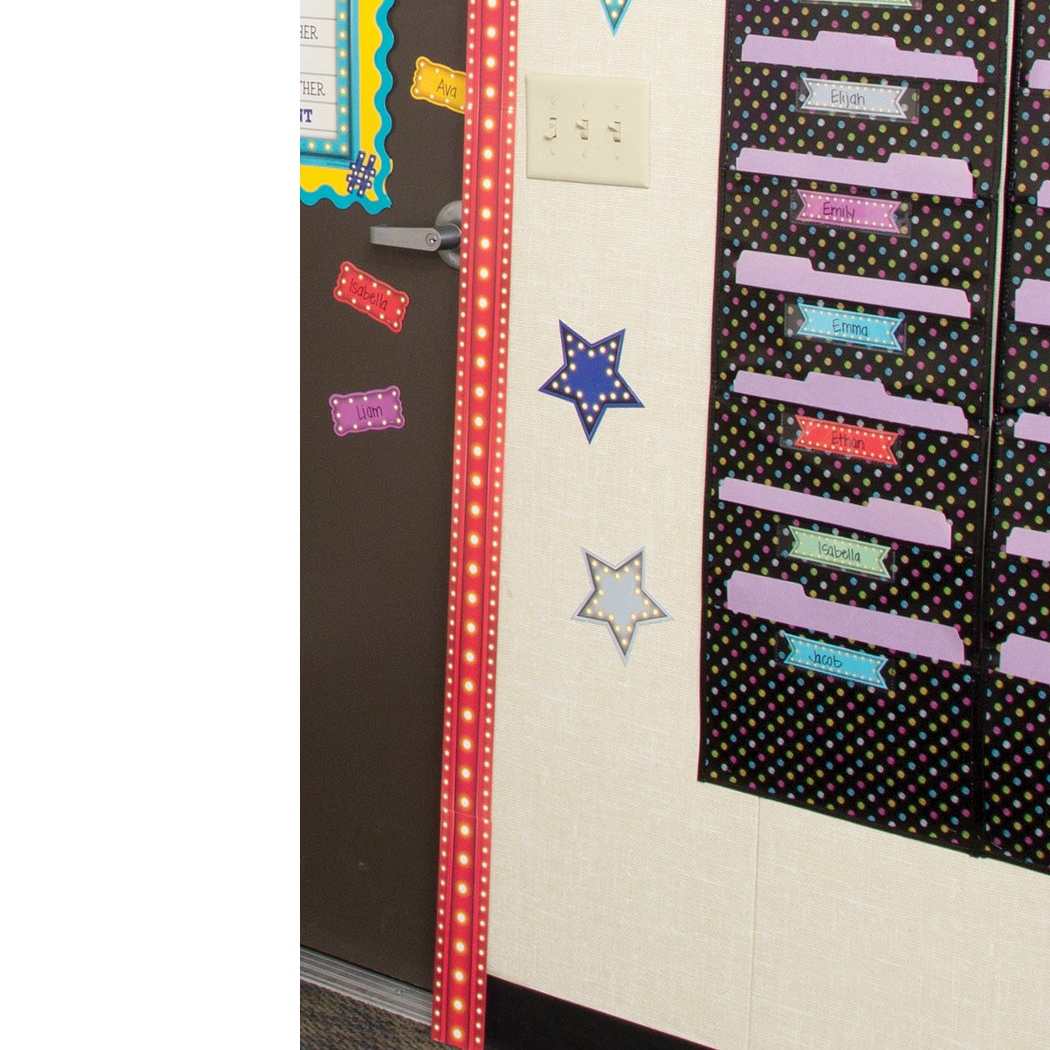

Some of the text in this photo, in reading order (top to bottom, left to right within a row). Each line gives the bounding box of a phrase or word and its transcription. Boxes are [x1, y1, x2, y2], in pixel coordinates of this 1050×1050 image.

[436, 78, 458, 99] Ava
[831, 89, 865, 108] Elijah
[823, 202, 856, 220] Emily
[349, 278, 389, 312] Isabella
[832, 318, 868, 337] Emma
[356, 404, 383, 421] Liam
[832, 431, 865, 450] Ethan
[818, 541, 861, 563] Isabella
[809, 651, 843, 669] Jacob
